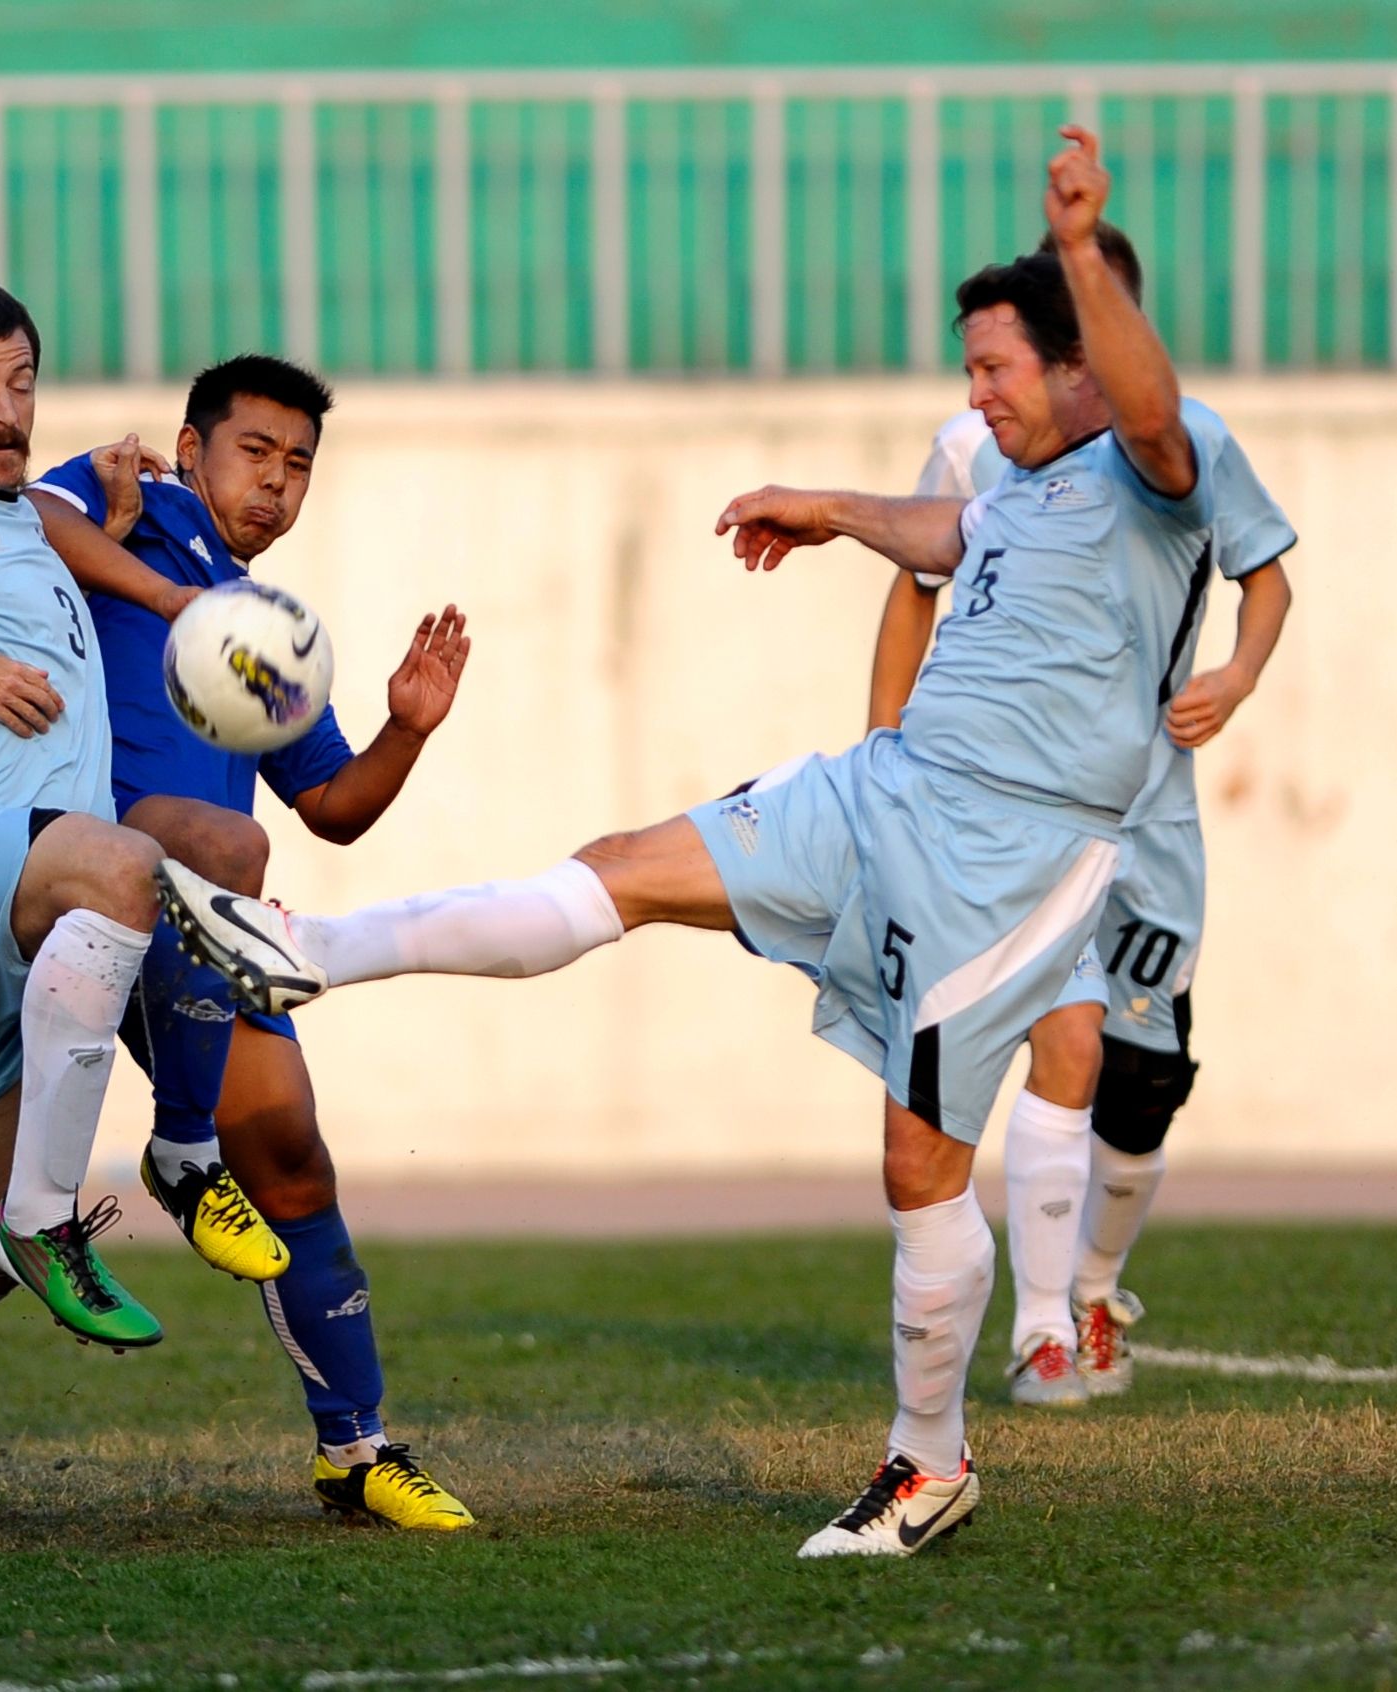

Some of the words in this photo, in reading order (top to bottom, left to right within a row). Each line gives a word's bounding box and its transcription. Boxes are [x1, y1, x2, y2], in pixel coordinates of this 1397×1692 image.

[966, 547, 1008, 618] 5
[53, 585, 87, 661] 3
[879, 916, 916, 1001] 5
[1106, 918, 1181, 988] 10
